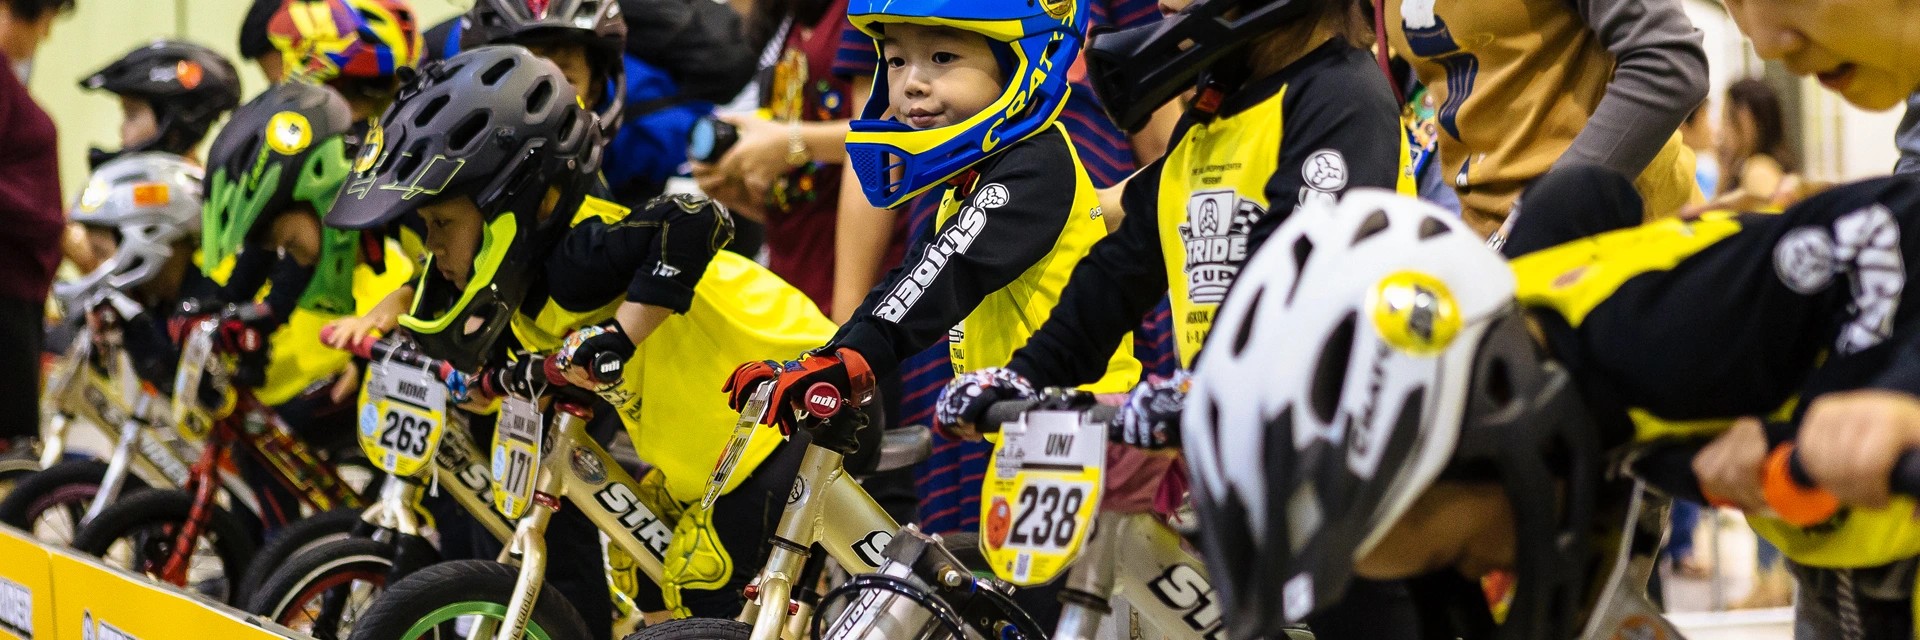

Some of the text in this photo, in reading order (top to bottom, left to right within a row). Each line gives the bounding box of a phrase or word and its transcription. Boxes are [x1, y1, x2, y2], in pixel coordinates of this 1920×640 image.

[601, 360, 620, 374] odi
[810, 394, 837, 409] odi
[380, 411, 432, 456] 263
[1045, 433, 1074, 457] UNI
[505, 449, 533, 498] 171
[1008, 485, 1083, 548] 238
